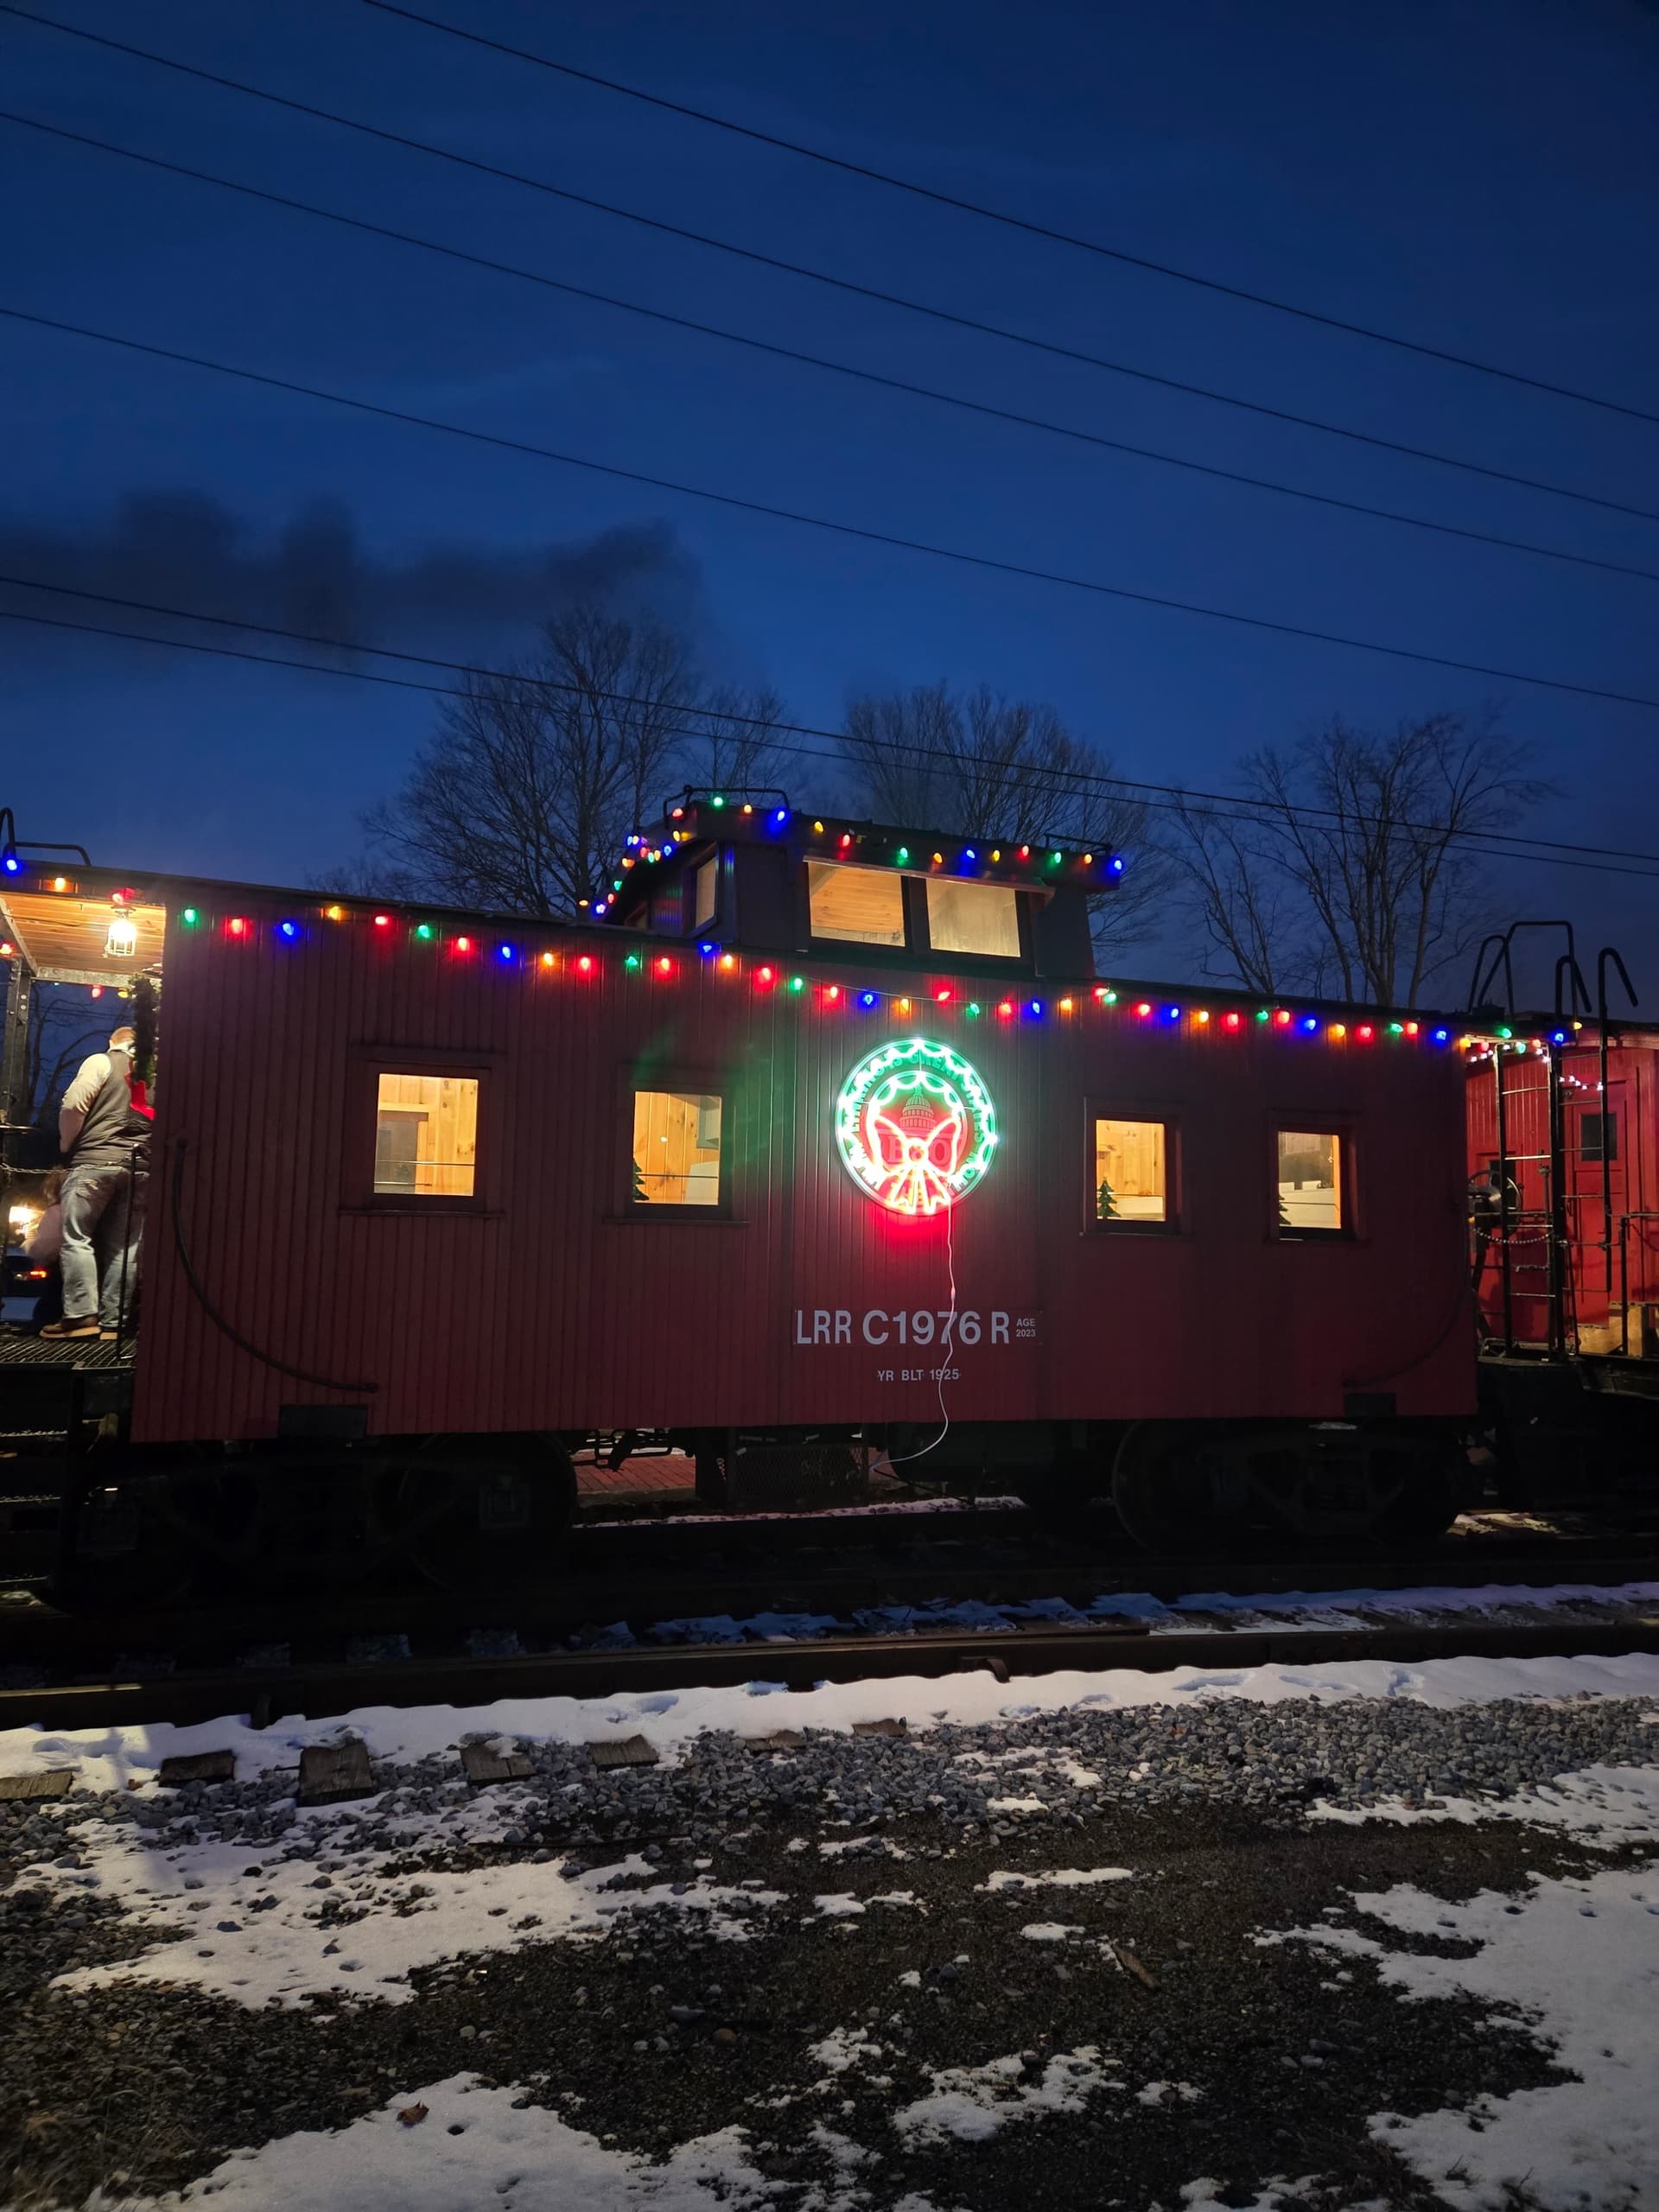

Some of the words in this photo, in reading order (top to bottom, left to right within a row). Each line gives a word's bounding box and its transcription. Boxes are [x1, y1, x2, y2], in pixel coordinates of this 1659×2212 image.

[797, 1310, 851, 1344] LRR
[862, 1310, 982, 1345] C1976
[991, 1311, 1010, 1344] R
[1016, 1318, 1036, 1327] AGE
[1015, 1329, 1037, 1338] 2023
[878, 1370, 894, 1381] YR
[901, 1370, 924, 1381] BLT
[929, 1369, 960, 1380] 1925
